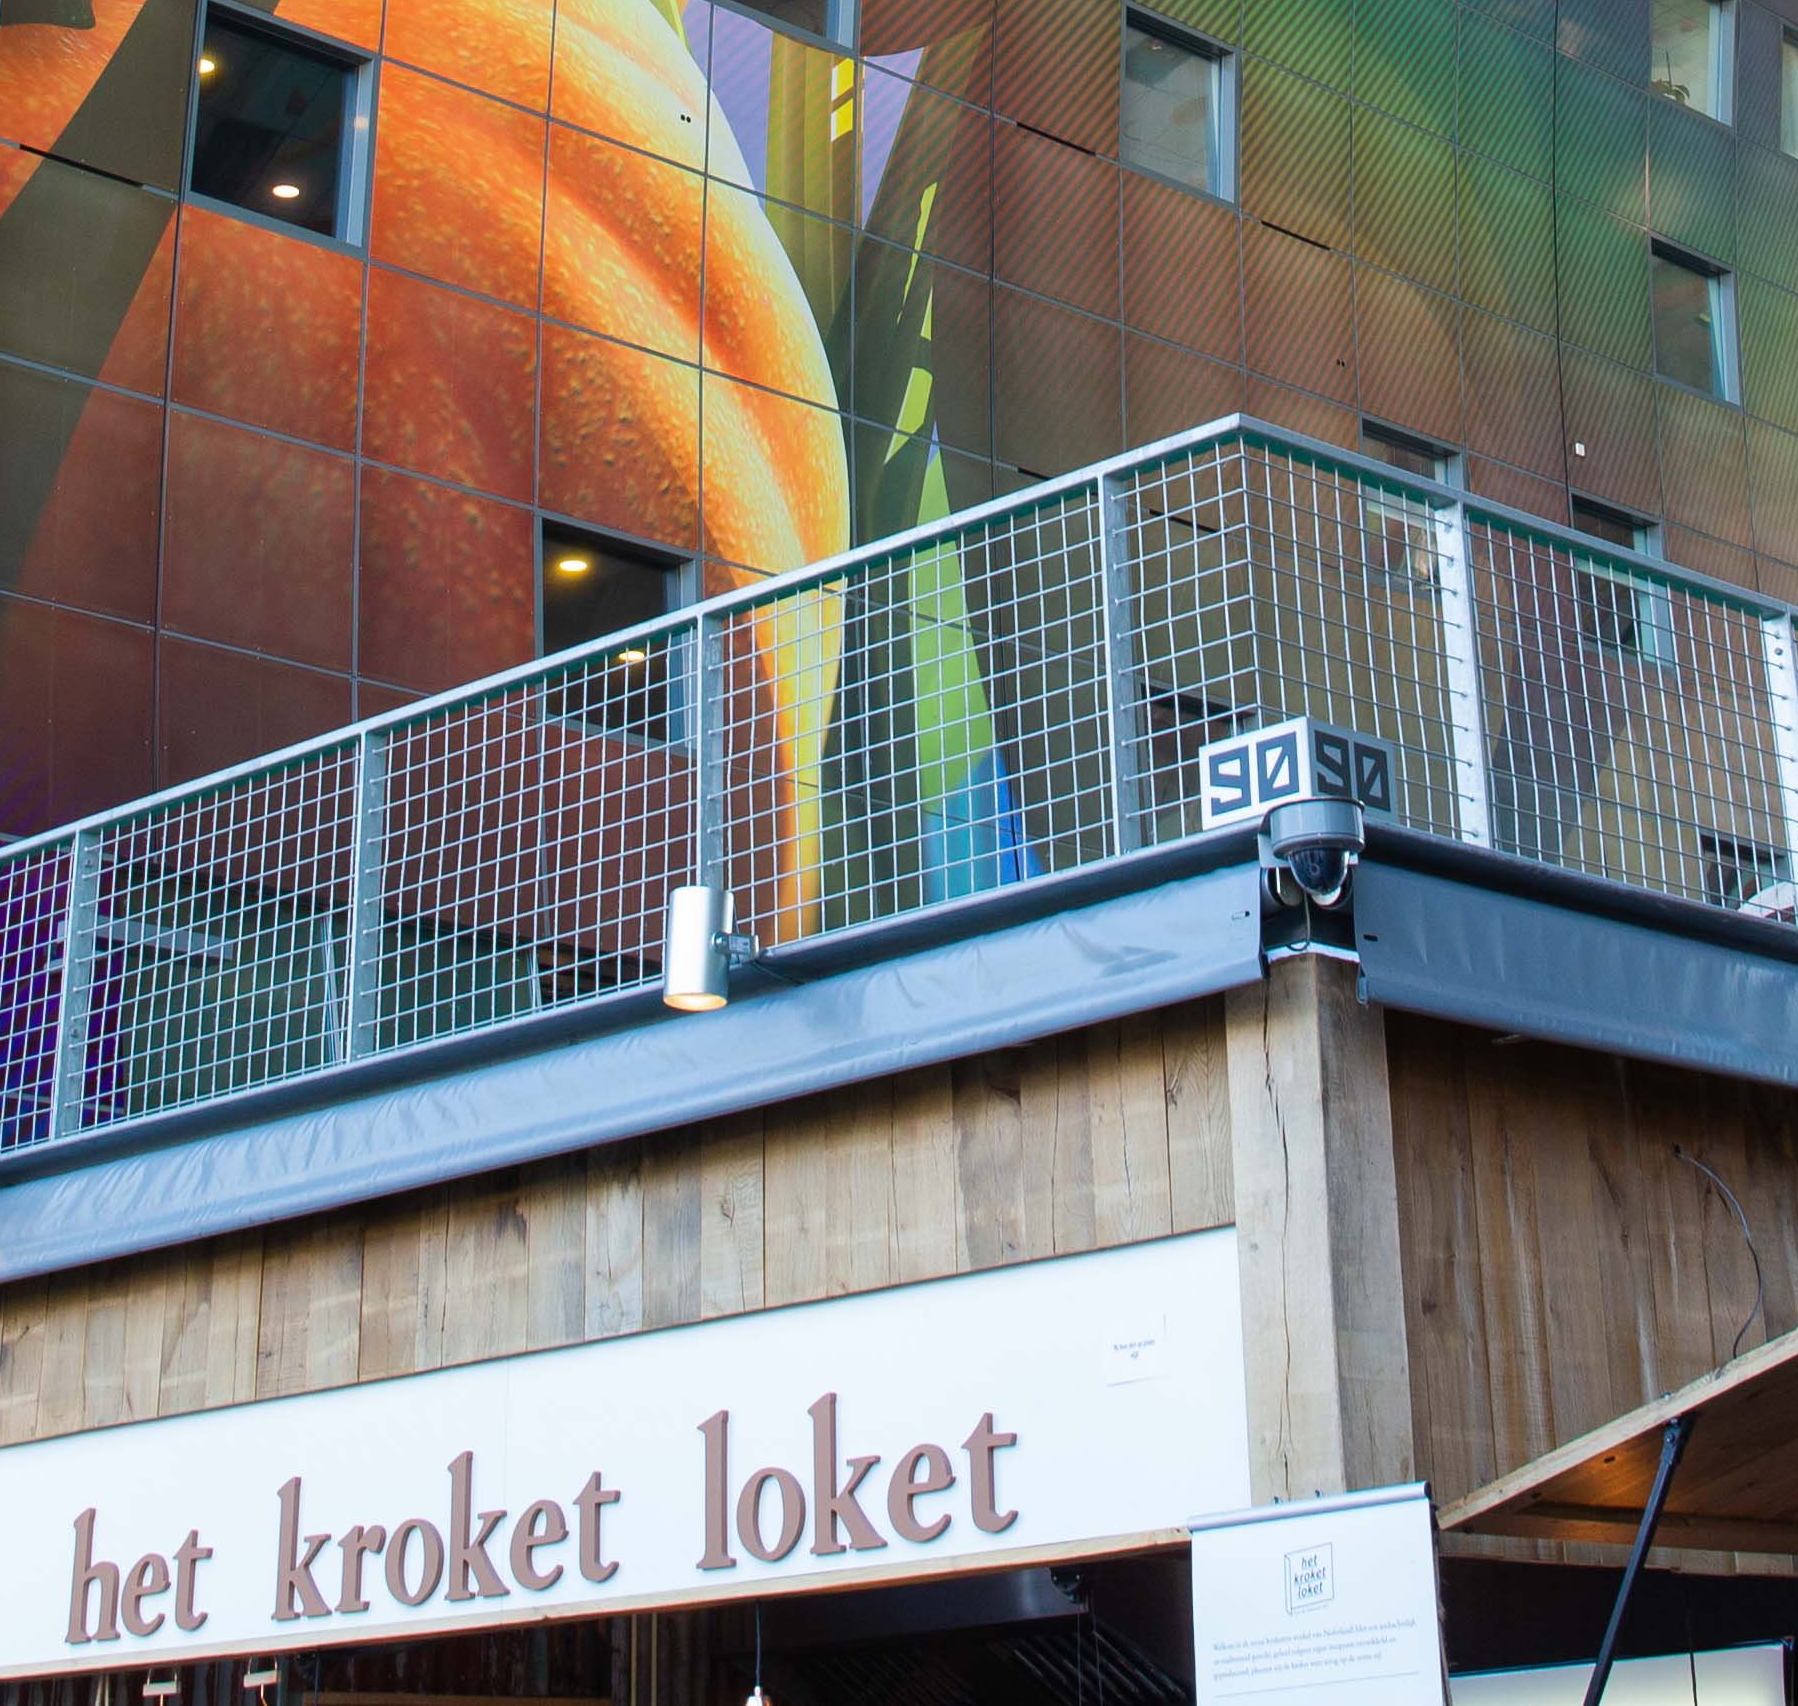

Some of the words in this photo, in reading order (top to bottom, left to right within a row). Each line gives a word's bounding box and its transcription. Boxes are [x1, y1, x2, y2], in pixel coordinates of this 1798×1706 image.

[1209, 732, 1300, 816] 90
[1314, 730, 1391, 811] 90
[64, 1507, 213, 1644] het
[270, 1451, 621, 1622] kroket
[696, 1391, 1018, 1570] loket
[1294, 1566, 1325, 1583] kroket
[1302, 1554, 1317, 1567] het
[1298, 1581, 1323, 1598] loket
